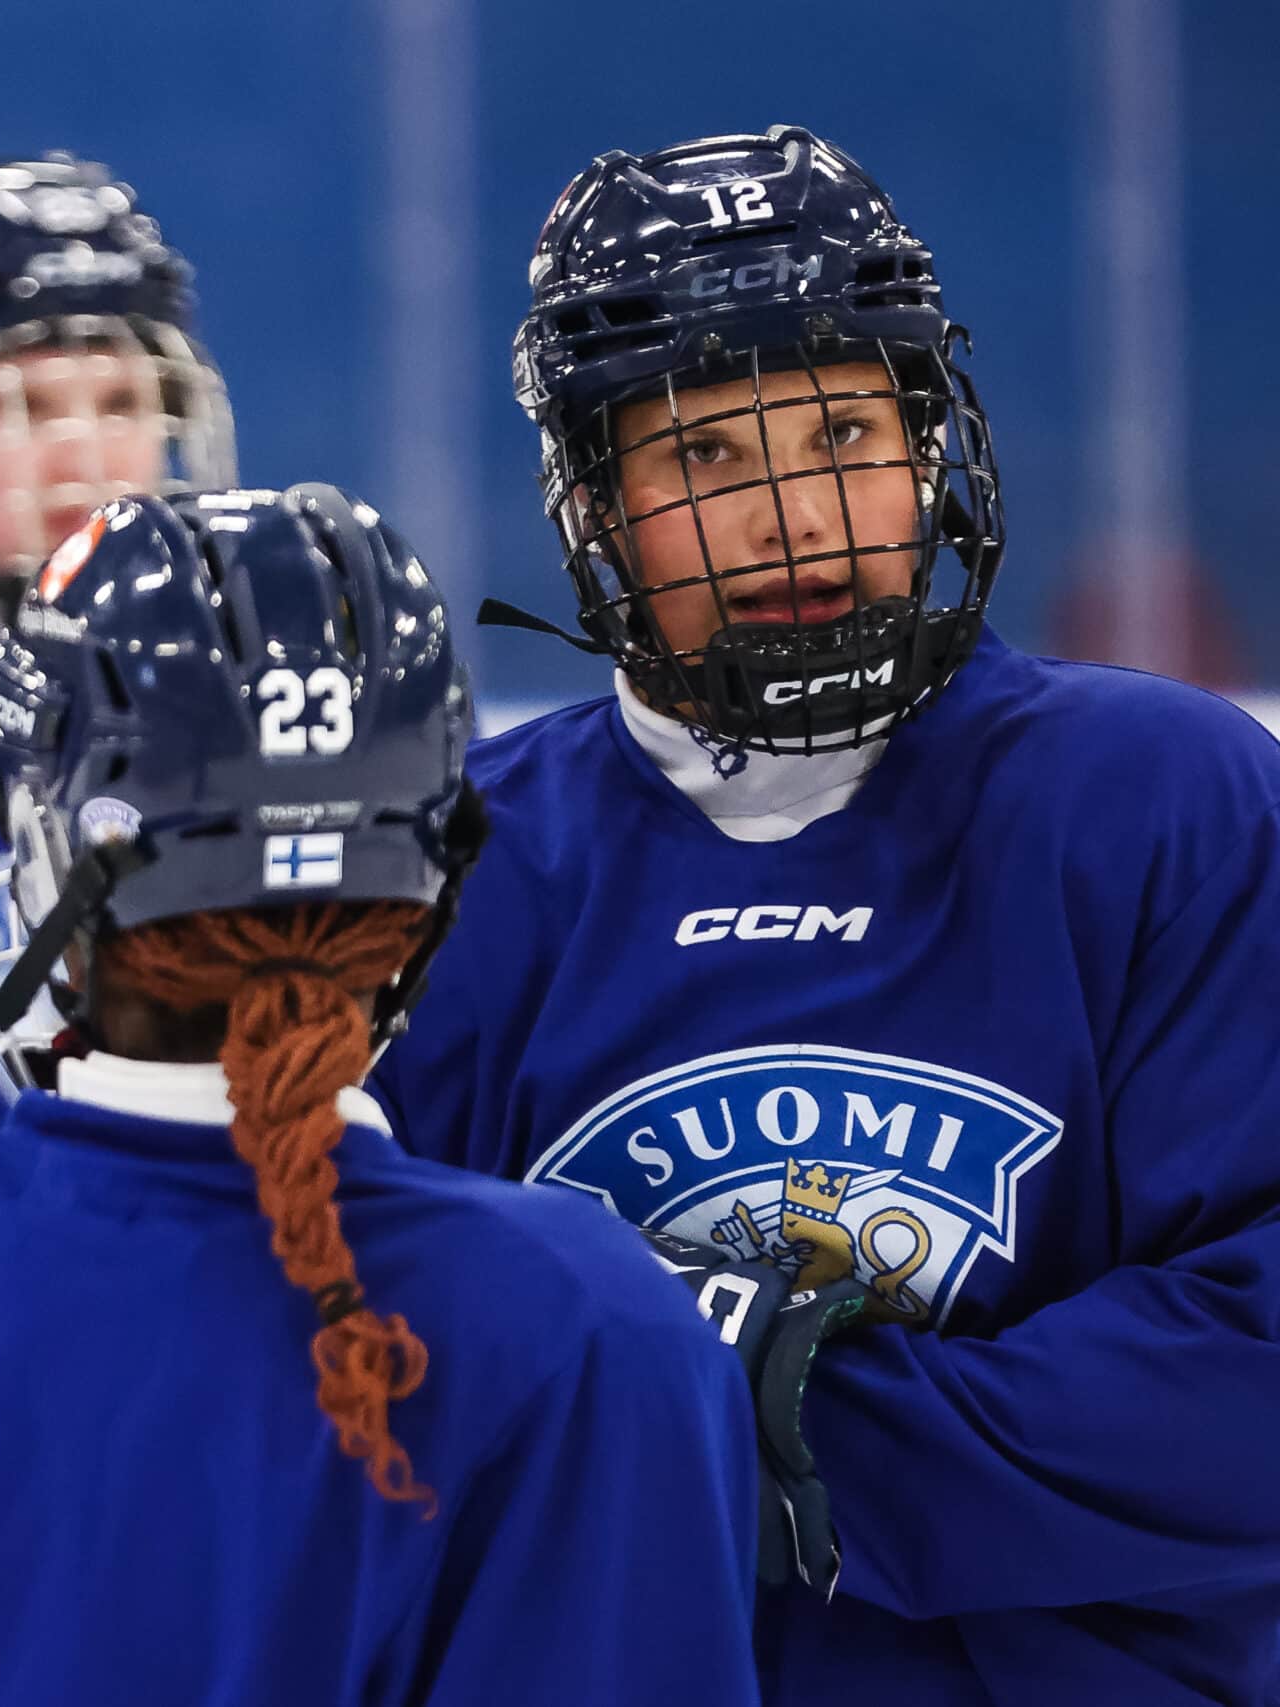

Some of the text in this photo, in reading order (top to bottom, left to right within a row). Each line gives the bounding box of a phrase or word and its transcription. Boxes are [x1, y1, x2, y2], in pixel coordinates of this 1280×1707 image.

[701, 180, 774, 228] 12
[689, 253, 824, 298] CCM
[257, 666, 354, 757] 23
[674, 905, 873, 946] CCM
[626, 1086, 964, 1188] SUOMI
